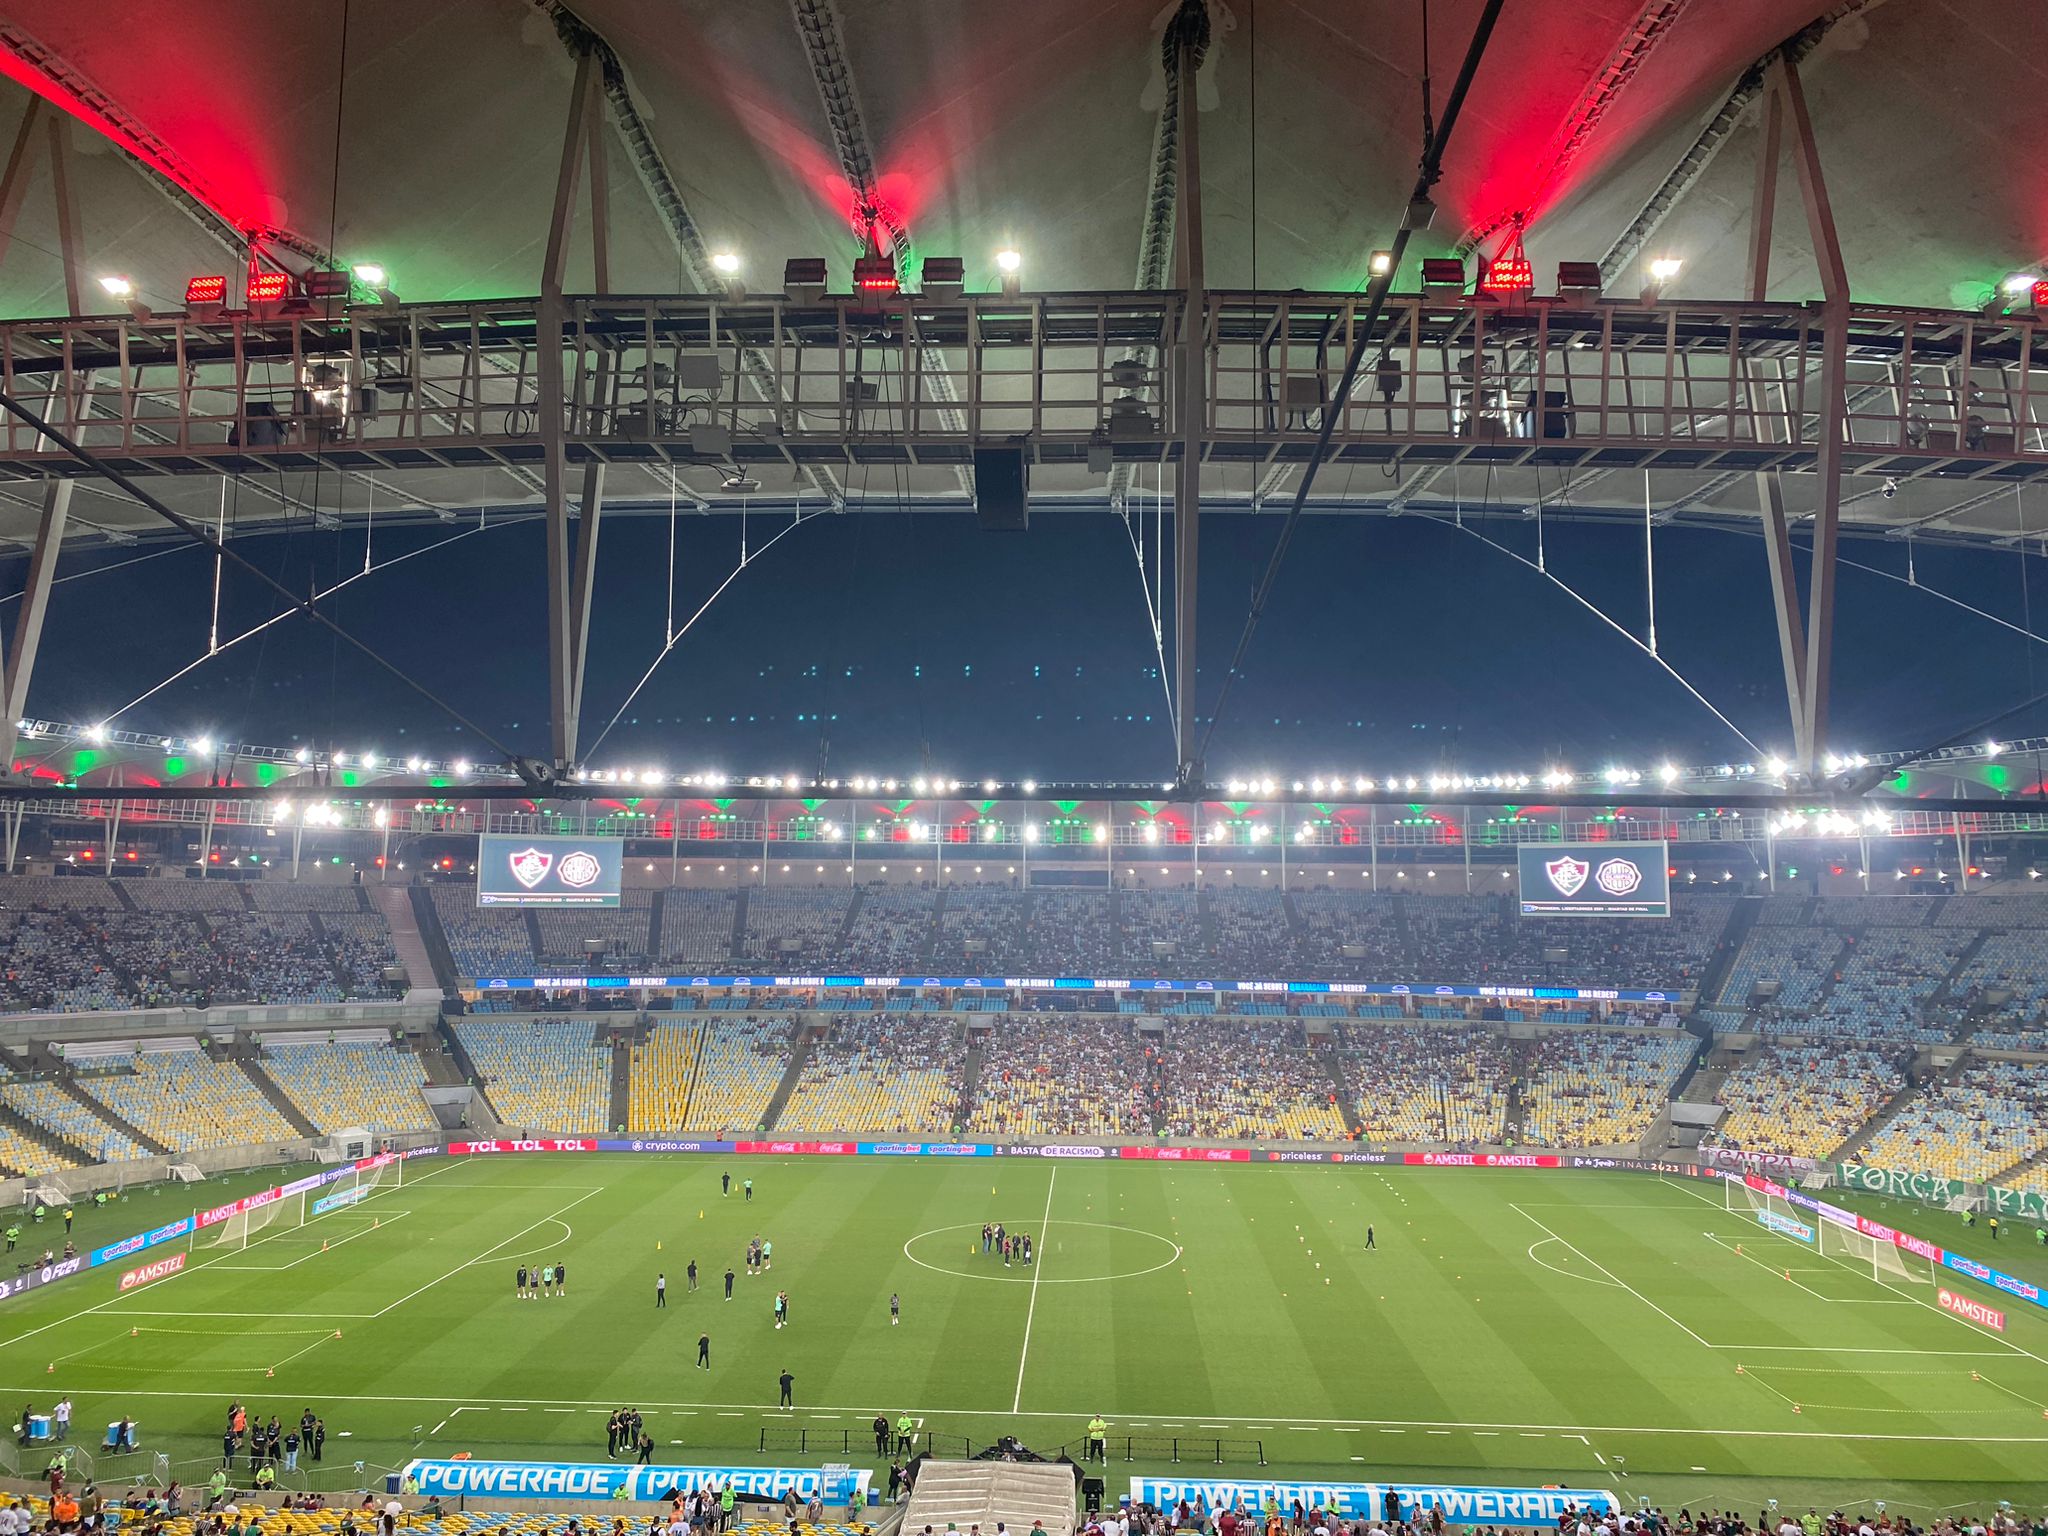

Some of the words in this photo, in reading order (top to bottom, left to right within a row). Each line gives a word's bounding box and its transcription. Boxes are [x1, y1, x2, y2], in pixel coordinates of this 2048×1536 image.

[407, 1146, 439, 1159] priceless
[467, 1140, 500, 1153] TCL
[511, 1140, 544, 1151] TCL
[554, 1140, 585, 1151] TCL
[645, 1141, 700, 1151] crypto.com
[874, 1144, 920, 1153] sportingbet
[929, 1145, 975, 1154] sportingbet
[1011, 1146, 1039, 1155] BASTA
[1045, 1147, 1057, 1155] DE
[1059, 1147, 1100, 1156] RACISMO
[1281, 1151, 1323, 1161] priceless
[1344, 1153, 1386, 1162] priceless
[1434, 1154, 1476, 1165] AMSTEL
[1498, 1155, 1539, 1166] AMSTEL
[1615, 1161, 1649, 1170] FINAL
[1650, 1162, 1680, 1172] 2023
[209, 1203, 237, 1223] AMSTEL
[250, 1190, 275, 1207] AMSTEL
[1790, 1193, 1818, 1208] crypto.com
[103, 1237, 143, 1259] sportingbet
[150, 1222, 187, 1241] sportingbet
[1868, 1221, 1895, 1241] AMSTEL
[1906, 1236, 1937, 1261] AMSTEL
[136, 1256, 183, 1284] AMSTEL
[1952, 1258, 1990, 1278] sportingbet
[1994, 1275, 2038, 1299] sportingbet
[1952, 1297, 2002, 1329] AMSTEL
[419, 1465, 612, 1494] POWERADE
[646, 1470, 839, 1499] POWERADE
[1153, 1482, 1352, 1513] POWERADE
